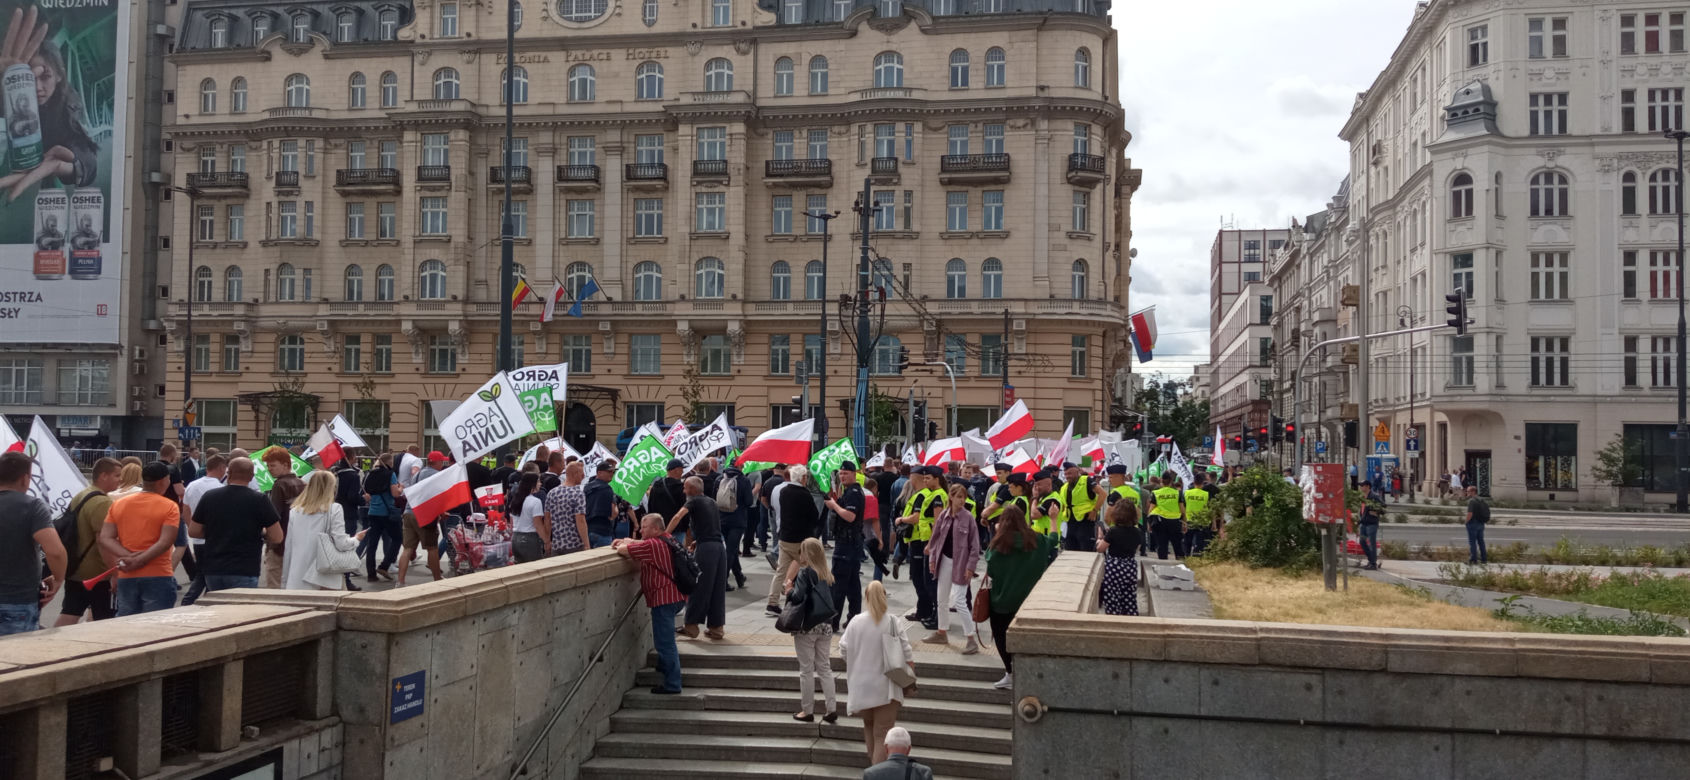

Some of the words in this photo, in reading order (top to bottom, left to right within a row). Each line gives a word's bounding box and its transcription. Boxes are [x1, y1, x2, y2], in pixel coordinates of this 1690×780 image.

[564, 50, 612, 62] PALACE
[625, 47, 669, 60] HOTEL
[37, 196, 67, 205] OSHEE
[72, 196, 102, 204] OSHEE
[1316, 442, 1324, 450] P
